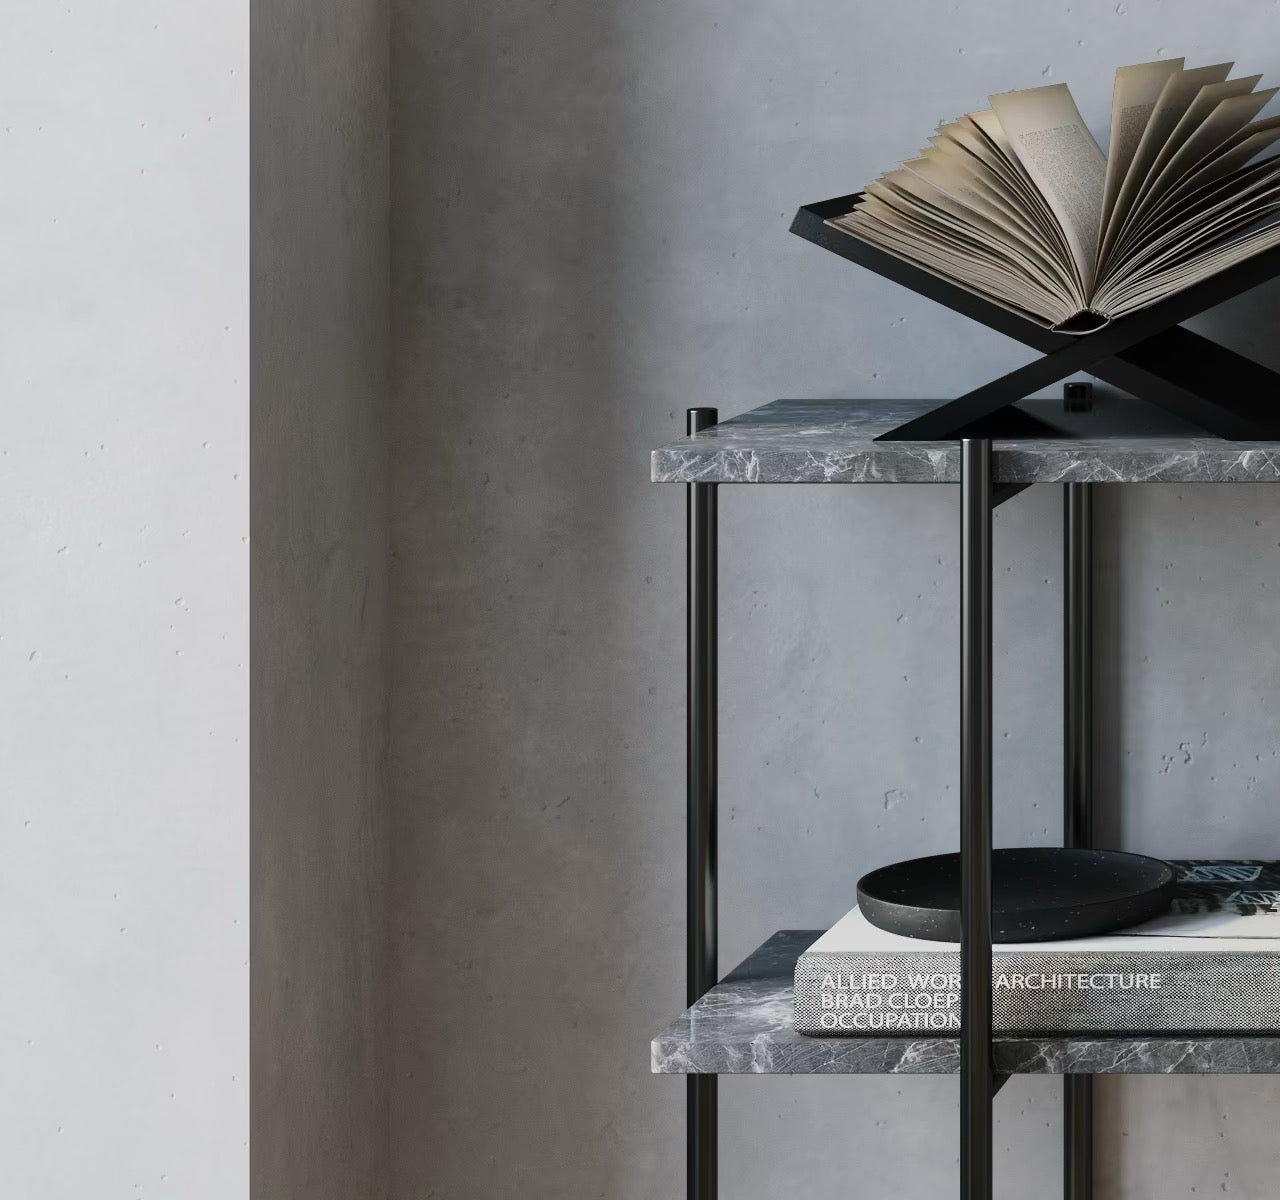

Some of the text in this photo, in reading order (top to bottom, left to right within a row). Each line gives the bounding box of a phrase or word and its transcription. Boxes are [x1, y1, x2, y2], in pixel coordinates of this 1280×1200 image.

[821, 973, 1163, 990] ALLIED WOR ARCHITECTURE
[820, 992, 960, 1010] BRAD CLOEP
